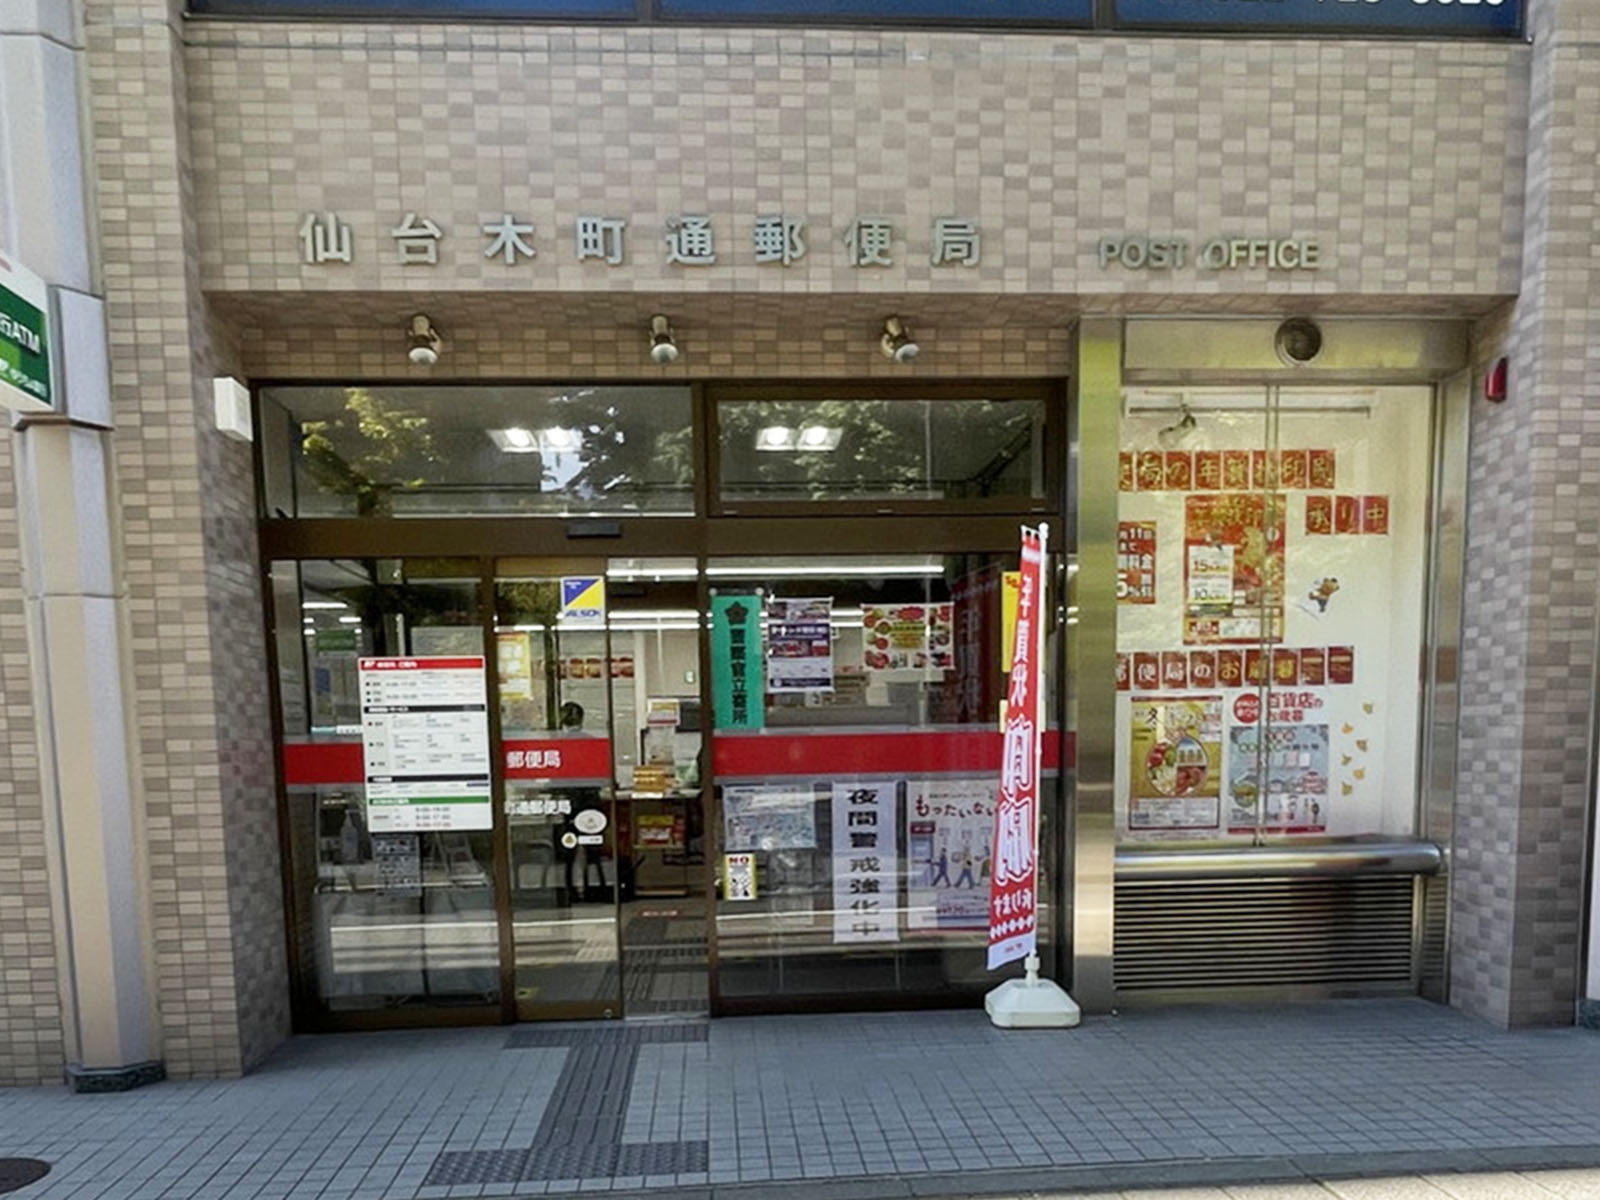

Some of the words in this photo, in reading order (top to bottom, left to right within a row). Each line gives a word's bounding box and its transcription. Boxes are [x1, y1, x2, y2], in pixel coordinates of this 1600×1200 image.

[299, 212, 982, 267] 仙台木町通郵便局
[1099, 238, 1187, 269] POST
[1203, 239, 1320, 270] OFFICE
[506, 750, 561, 769] 郵便局
[848, 788, 881, 936] 夜間警戒強化中
